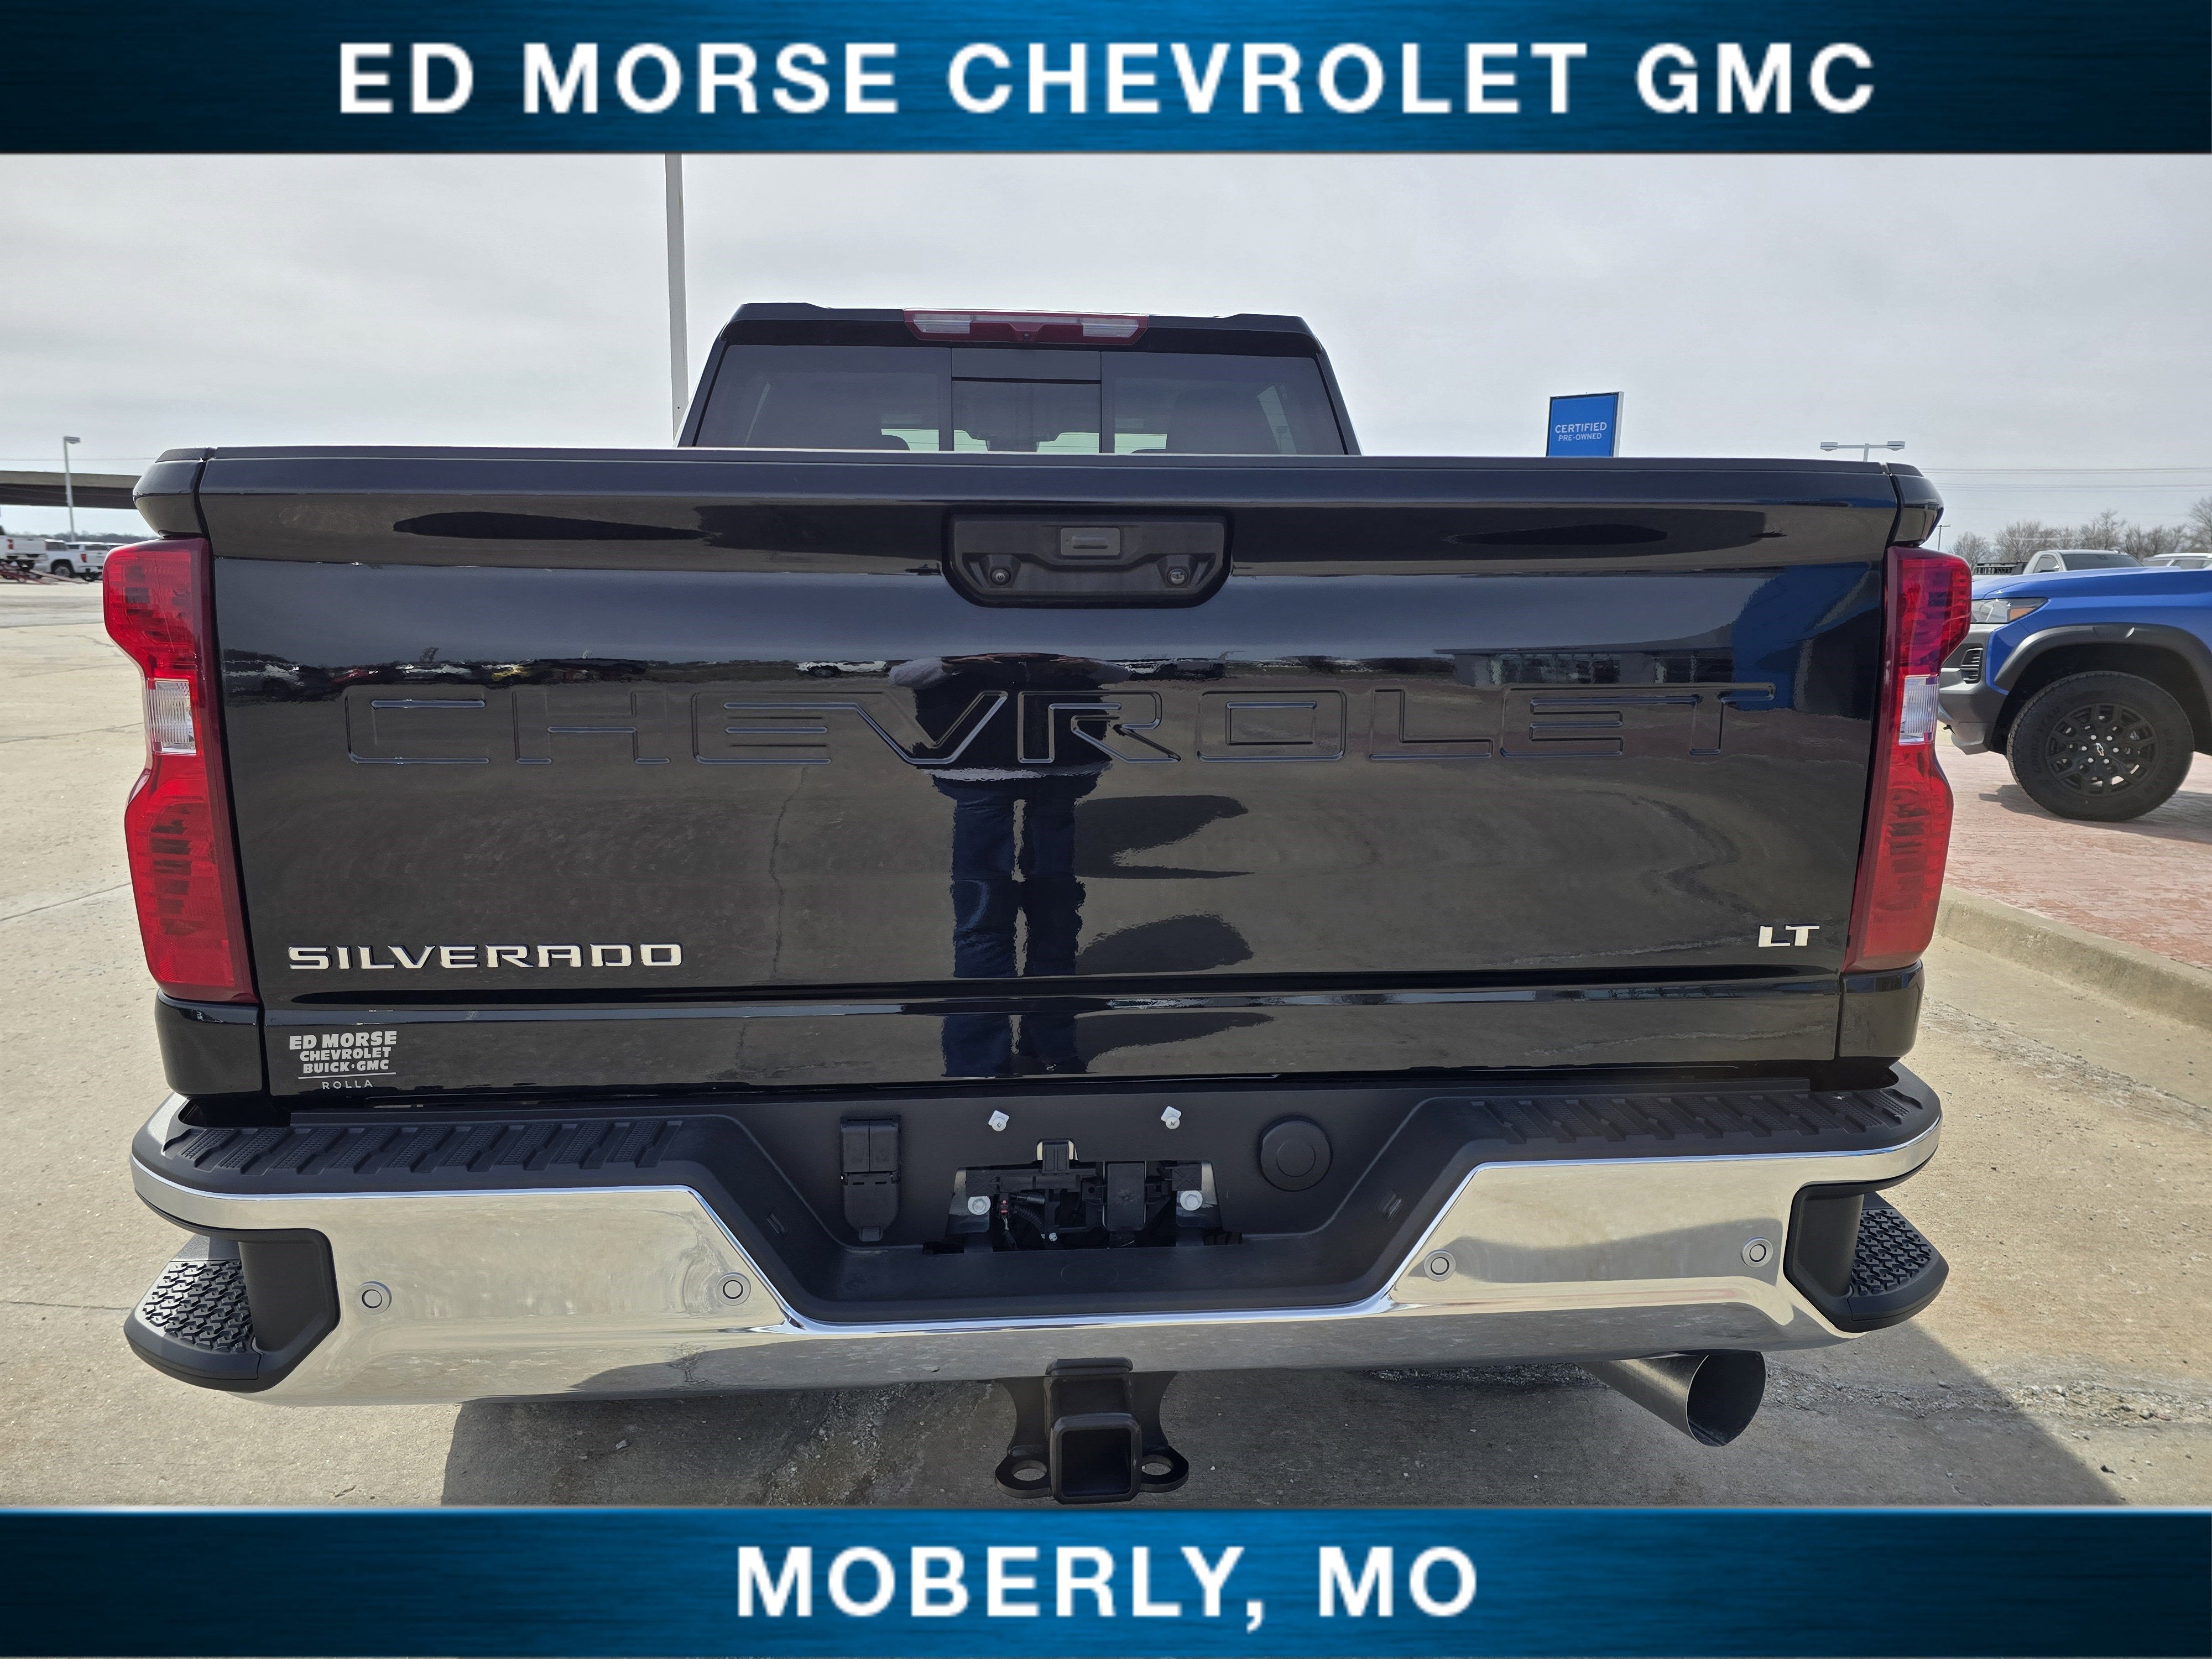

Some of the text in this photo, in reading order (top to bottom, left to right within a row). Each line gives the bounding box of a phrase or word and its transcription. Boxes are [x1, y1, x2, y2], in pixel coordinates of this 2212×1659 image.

[1554, 421, 1607, 434] CERTIFIED
[1558, 432, 1602, 441] PRE-OWNED
[344, 682, 1776, 764] CHEVROLET
[1757, 924, 1820, 947] LT
[288, 943, 682, 969] SILVERADO
[289, 1030, 397, 1050] ED MORSE
[299, 1046, 392, 1062] CHEVROLET
[322, 1079, 373, 1090] ROLLA
